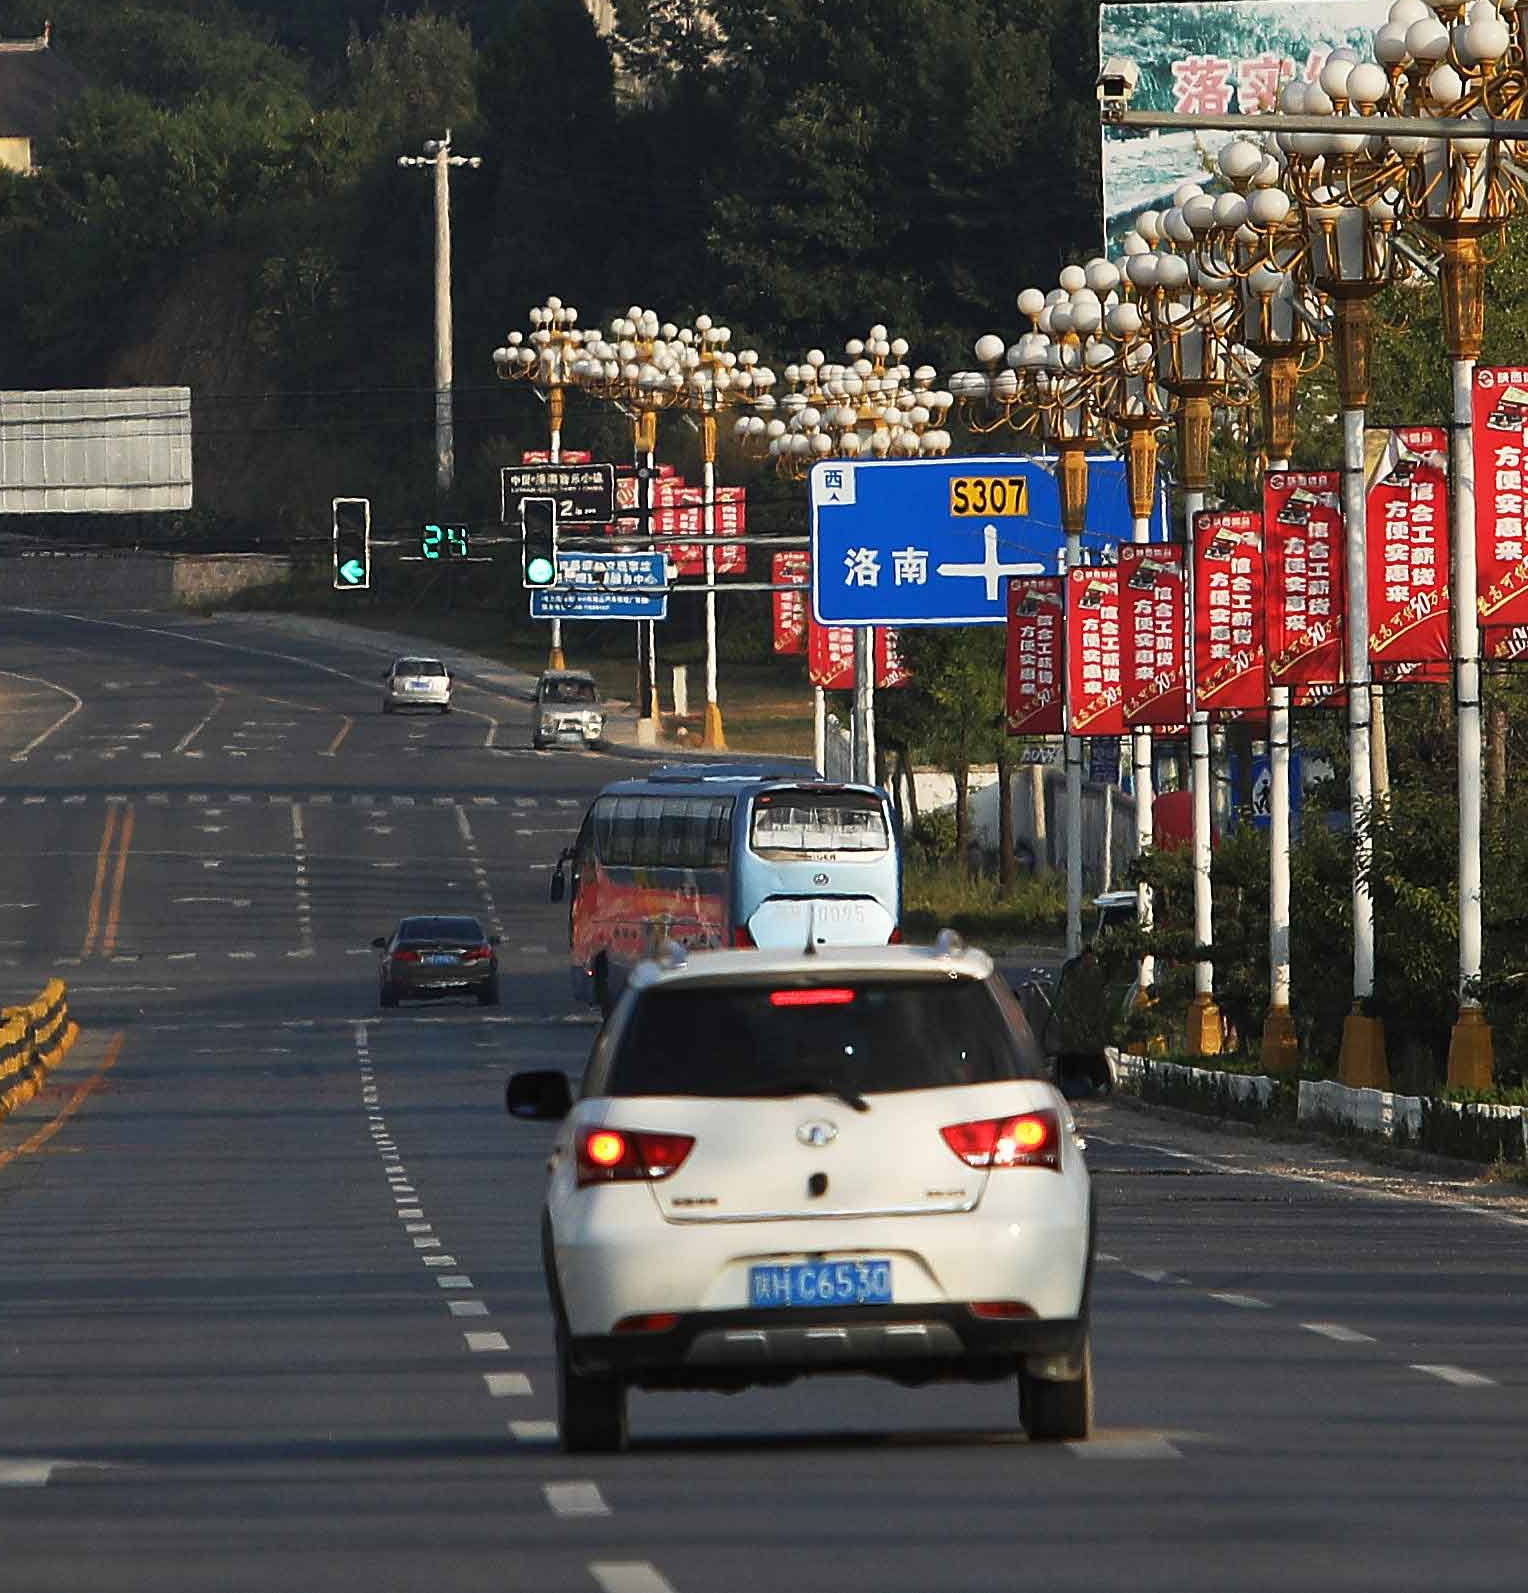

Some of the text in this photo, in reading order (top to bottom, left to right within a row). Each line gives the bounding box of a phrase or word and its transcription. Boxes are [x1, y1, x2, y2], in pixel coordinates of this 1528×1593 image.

[824, 470, 843, 489] 西
[952, 478, 1025, 514] S307
[559, 499, 574, 517] 2
[422, 524, 467, 558] 24
[843, 546, 929, 587] 洛南
